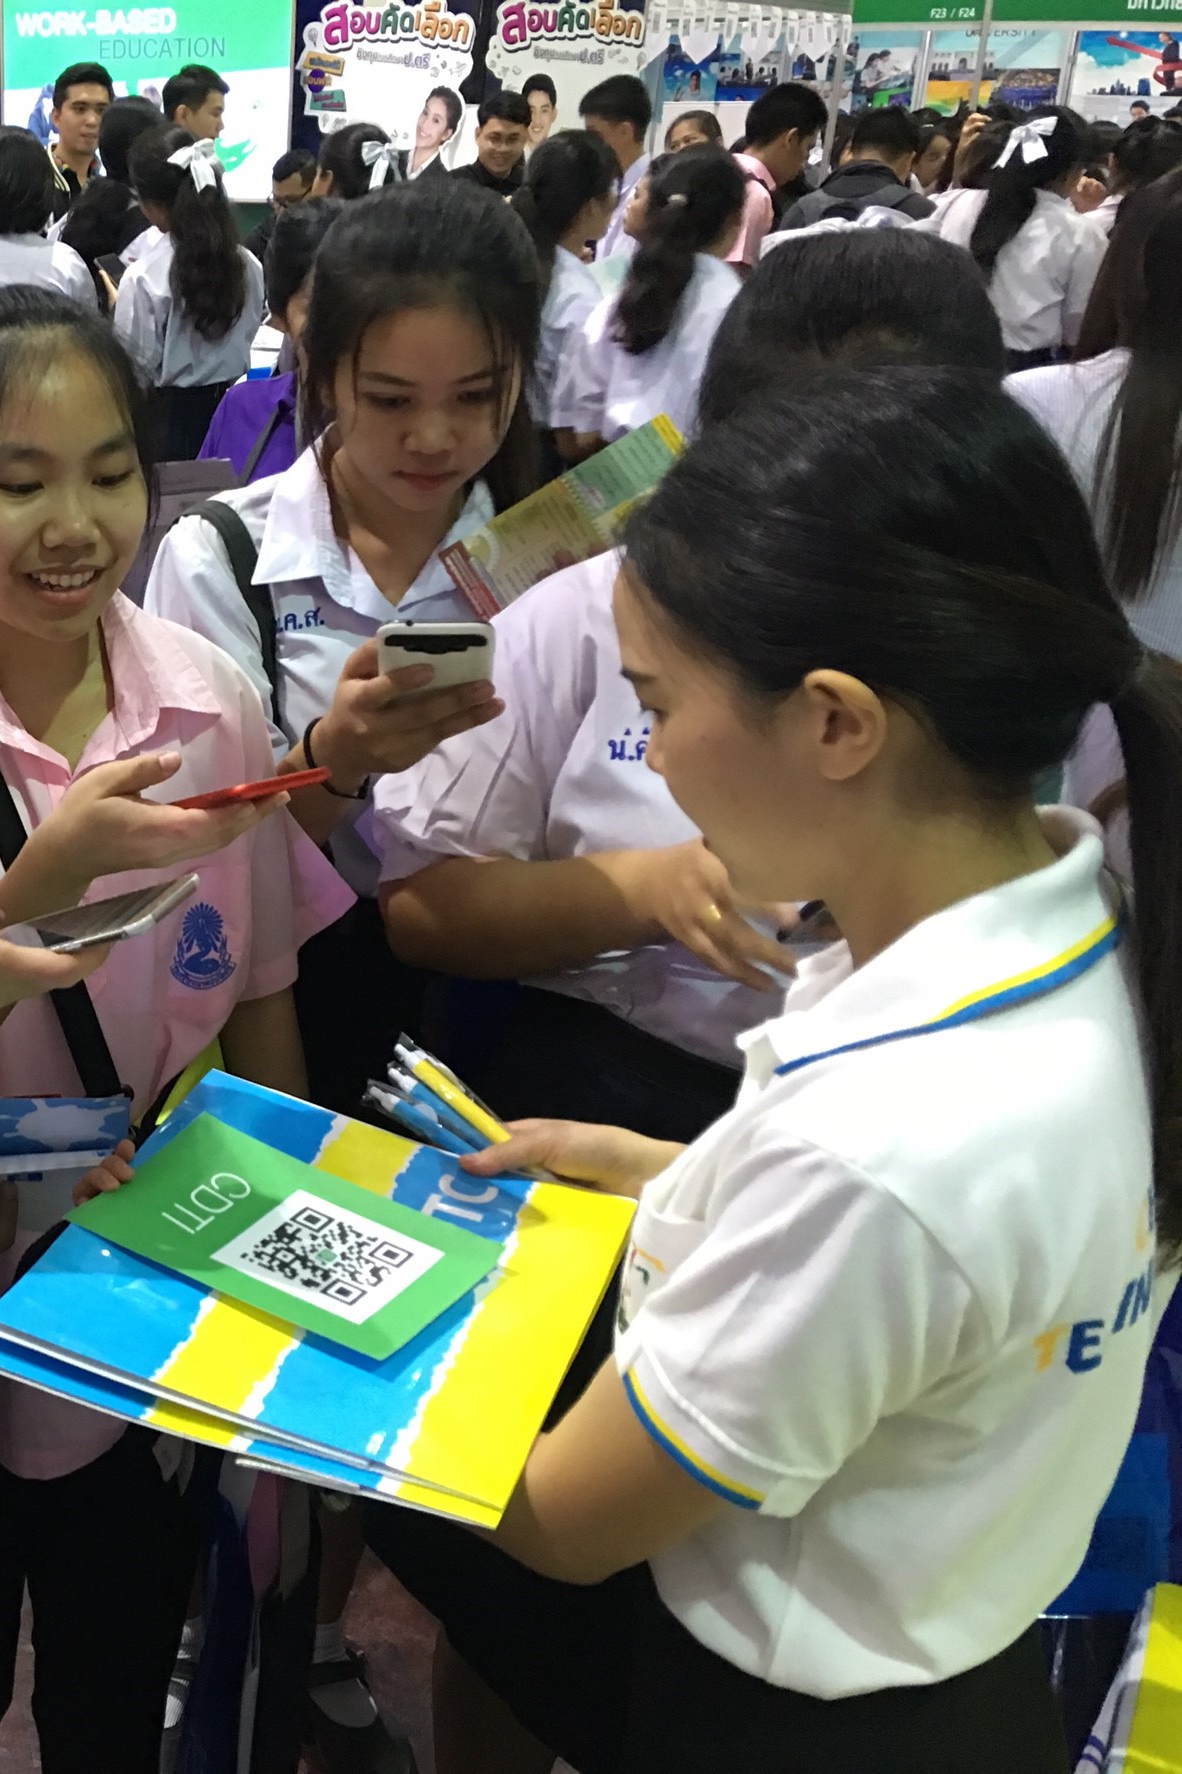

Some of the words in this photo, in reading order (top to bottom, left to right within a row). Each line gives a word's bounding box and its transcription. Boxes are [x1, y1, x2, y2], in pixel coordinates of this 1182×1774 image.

[15, 8, 177, 37] WORK-BASED
[324, 0, 470, 46] สอบคัดเลือก
[502, 0, 642, 46] สอบคัดเลือก
[930, 8, 947, 19] F23
[958, 7, 975, 18] F24
[99, 37, 225, 60] EDUCATION
[161, 1172, 251, 1235] CDTI
